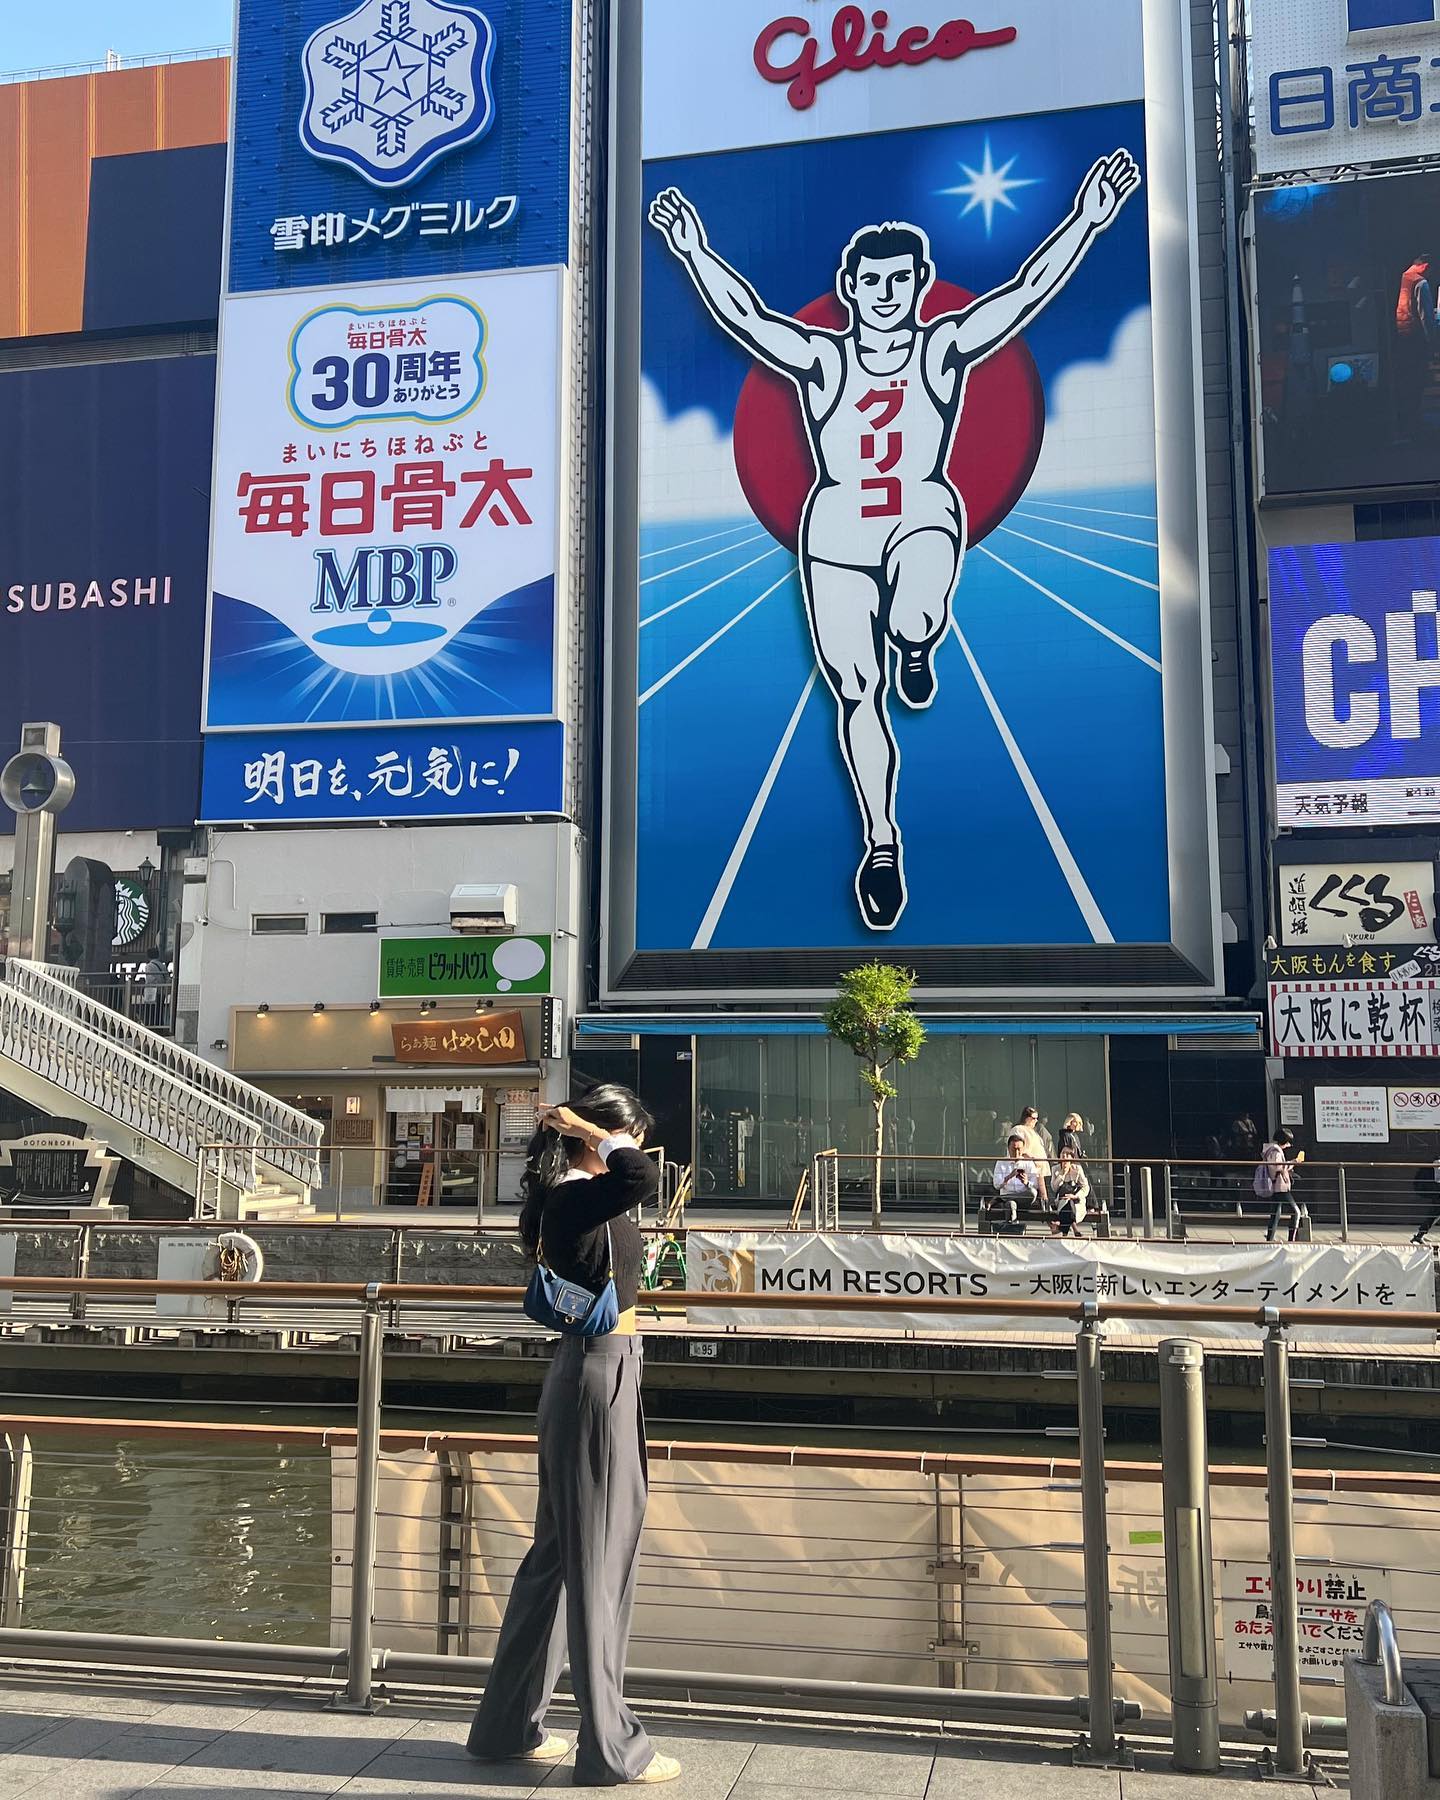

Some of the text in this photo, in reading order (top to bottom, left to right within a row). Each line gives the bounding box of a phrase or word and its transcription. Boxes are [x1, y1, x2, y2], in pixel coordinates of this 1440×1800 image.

[753, 5, 1017, 111] Glico
[1269, 54, 1440, 135] 日商
[269, 194, 518, 251] 雪印メグミルク
[347, 328, 427, 350] 毎日骨太
[394, 384, 461, 403] ありがとう
[282, 430, 489, 463] まいにちほねぶと
[854, 379, 908, 518] グリコ
[236, 458, 533, 537] 毎日骨太
[6, 576, 171, 613] SUBASHI
[310, 543, 458, 613] MBP
[1295, 793, 1368, 815] 天気予報
[1309, 874, 1405, 932] くくる
[429, 952, 488, 980] ピタットハウス
[1271, 951, 1396, 976] 大阪もんを食す
[1280, 992, 1426, 1044] 大阪に乾杯
[23, 1139, 75, 1147] DOTONBORI
[761, 1268, 988, 1296] MGM RESORTS
[1030, 1273, 1396, 1305] 大阪に新しいエンターテイメントを
